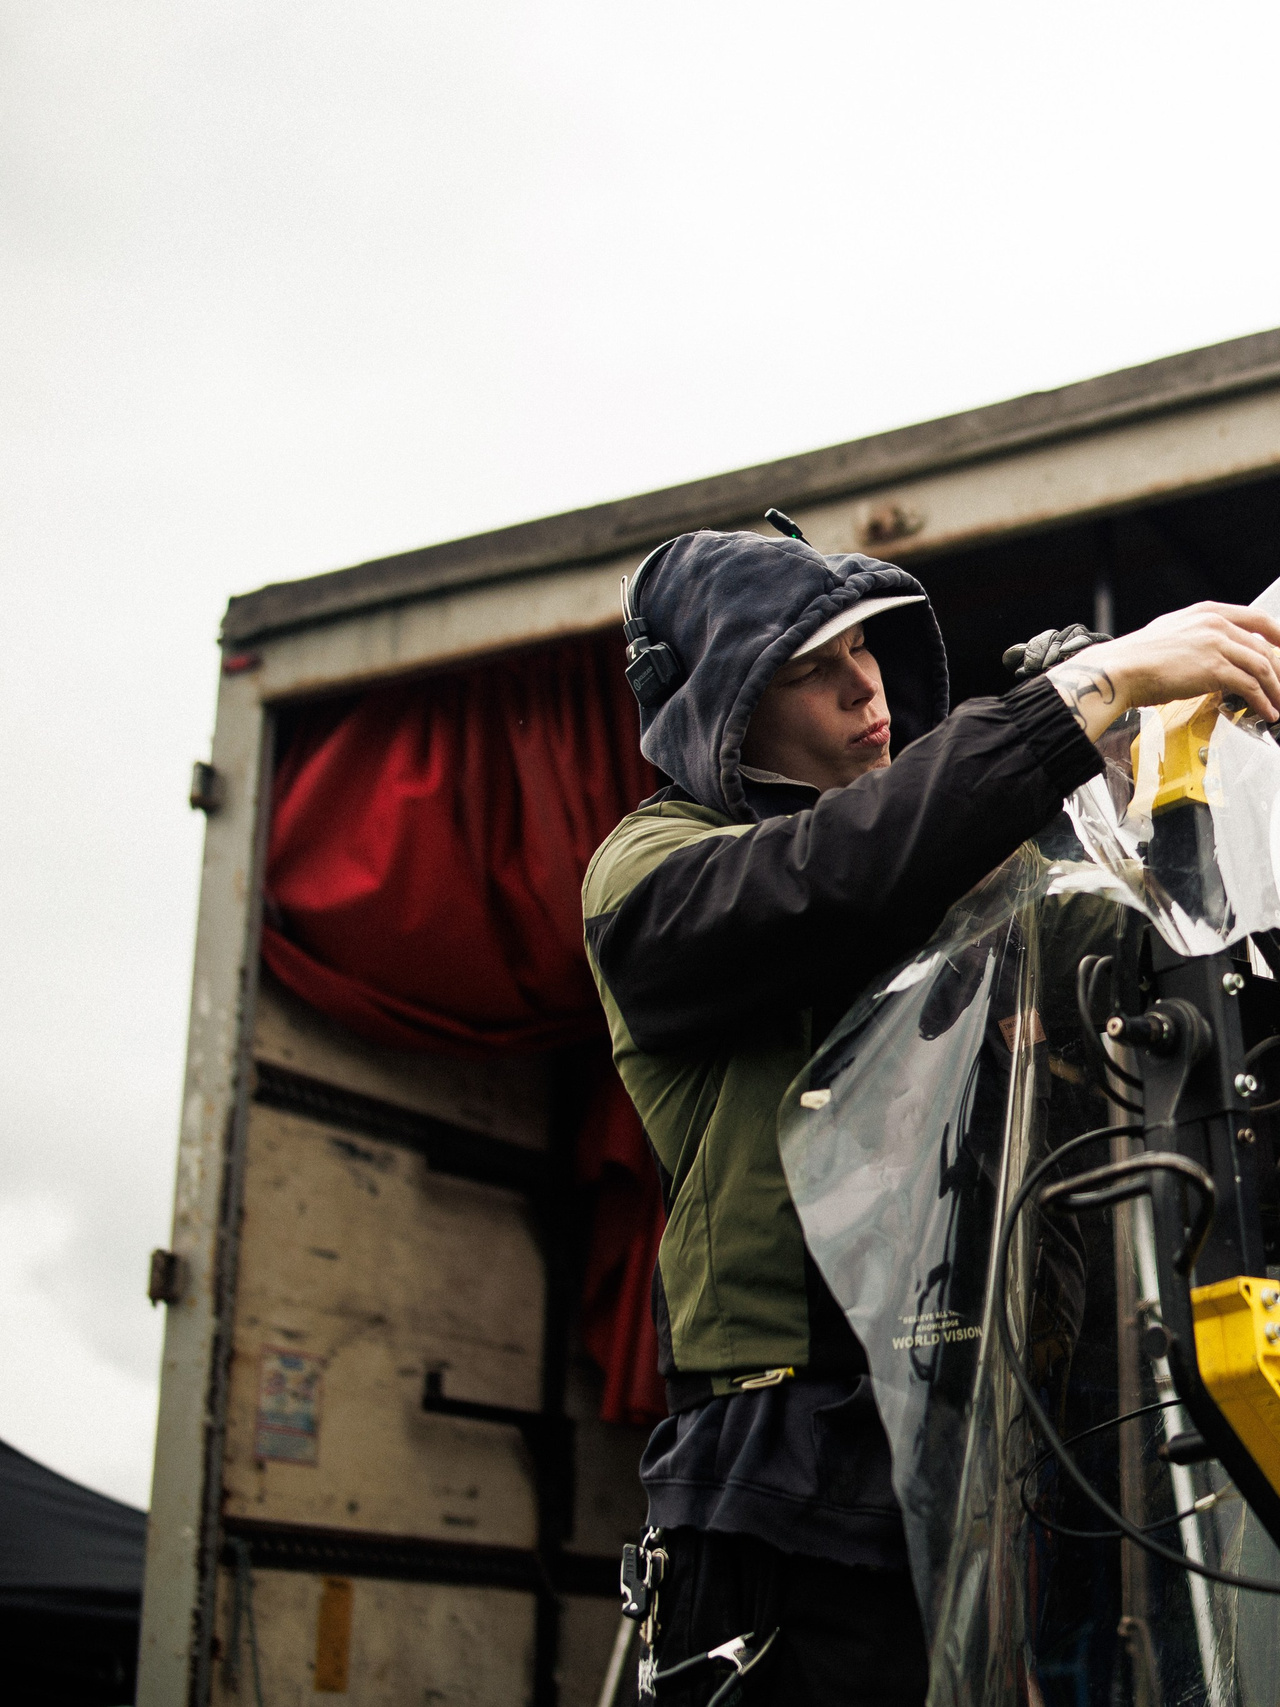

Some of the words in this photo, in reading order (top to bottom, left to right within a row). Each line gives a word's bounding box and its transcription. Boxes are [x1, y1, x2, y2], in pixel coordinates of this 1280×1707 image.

[629, 645, 637, 659] 2
[892, 1333, 939, 1349] WORLD
[943, 1325, 983, 1342] VISION
